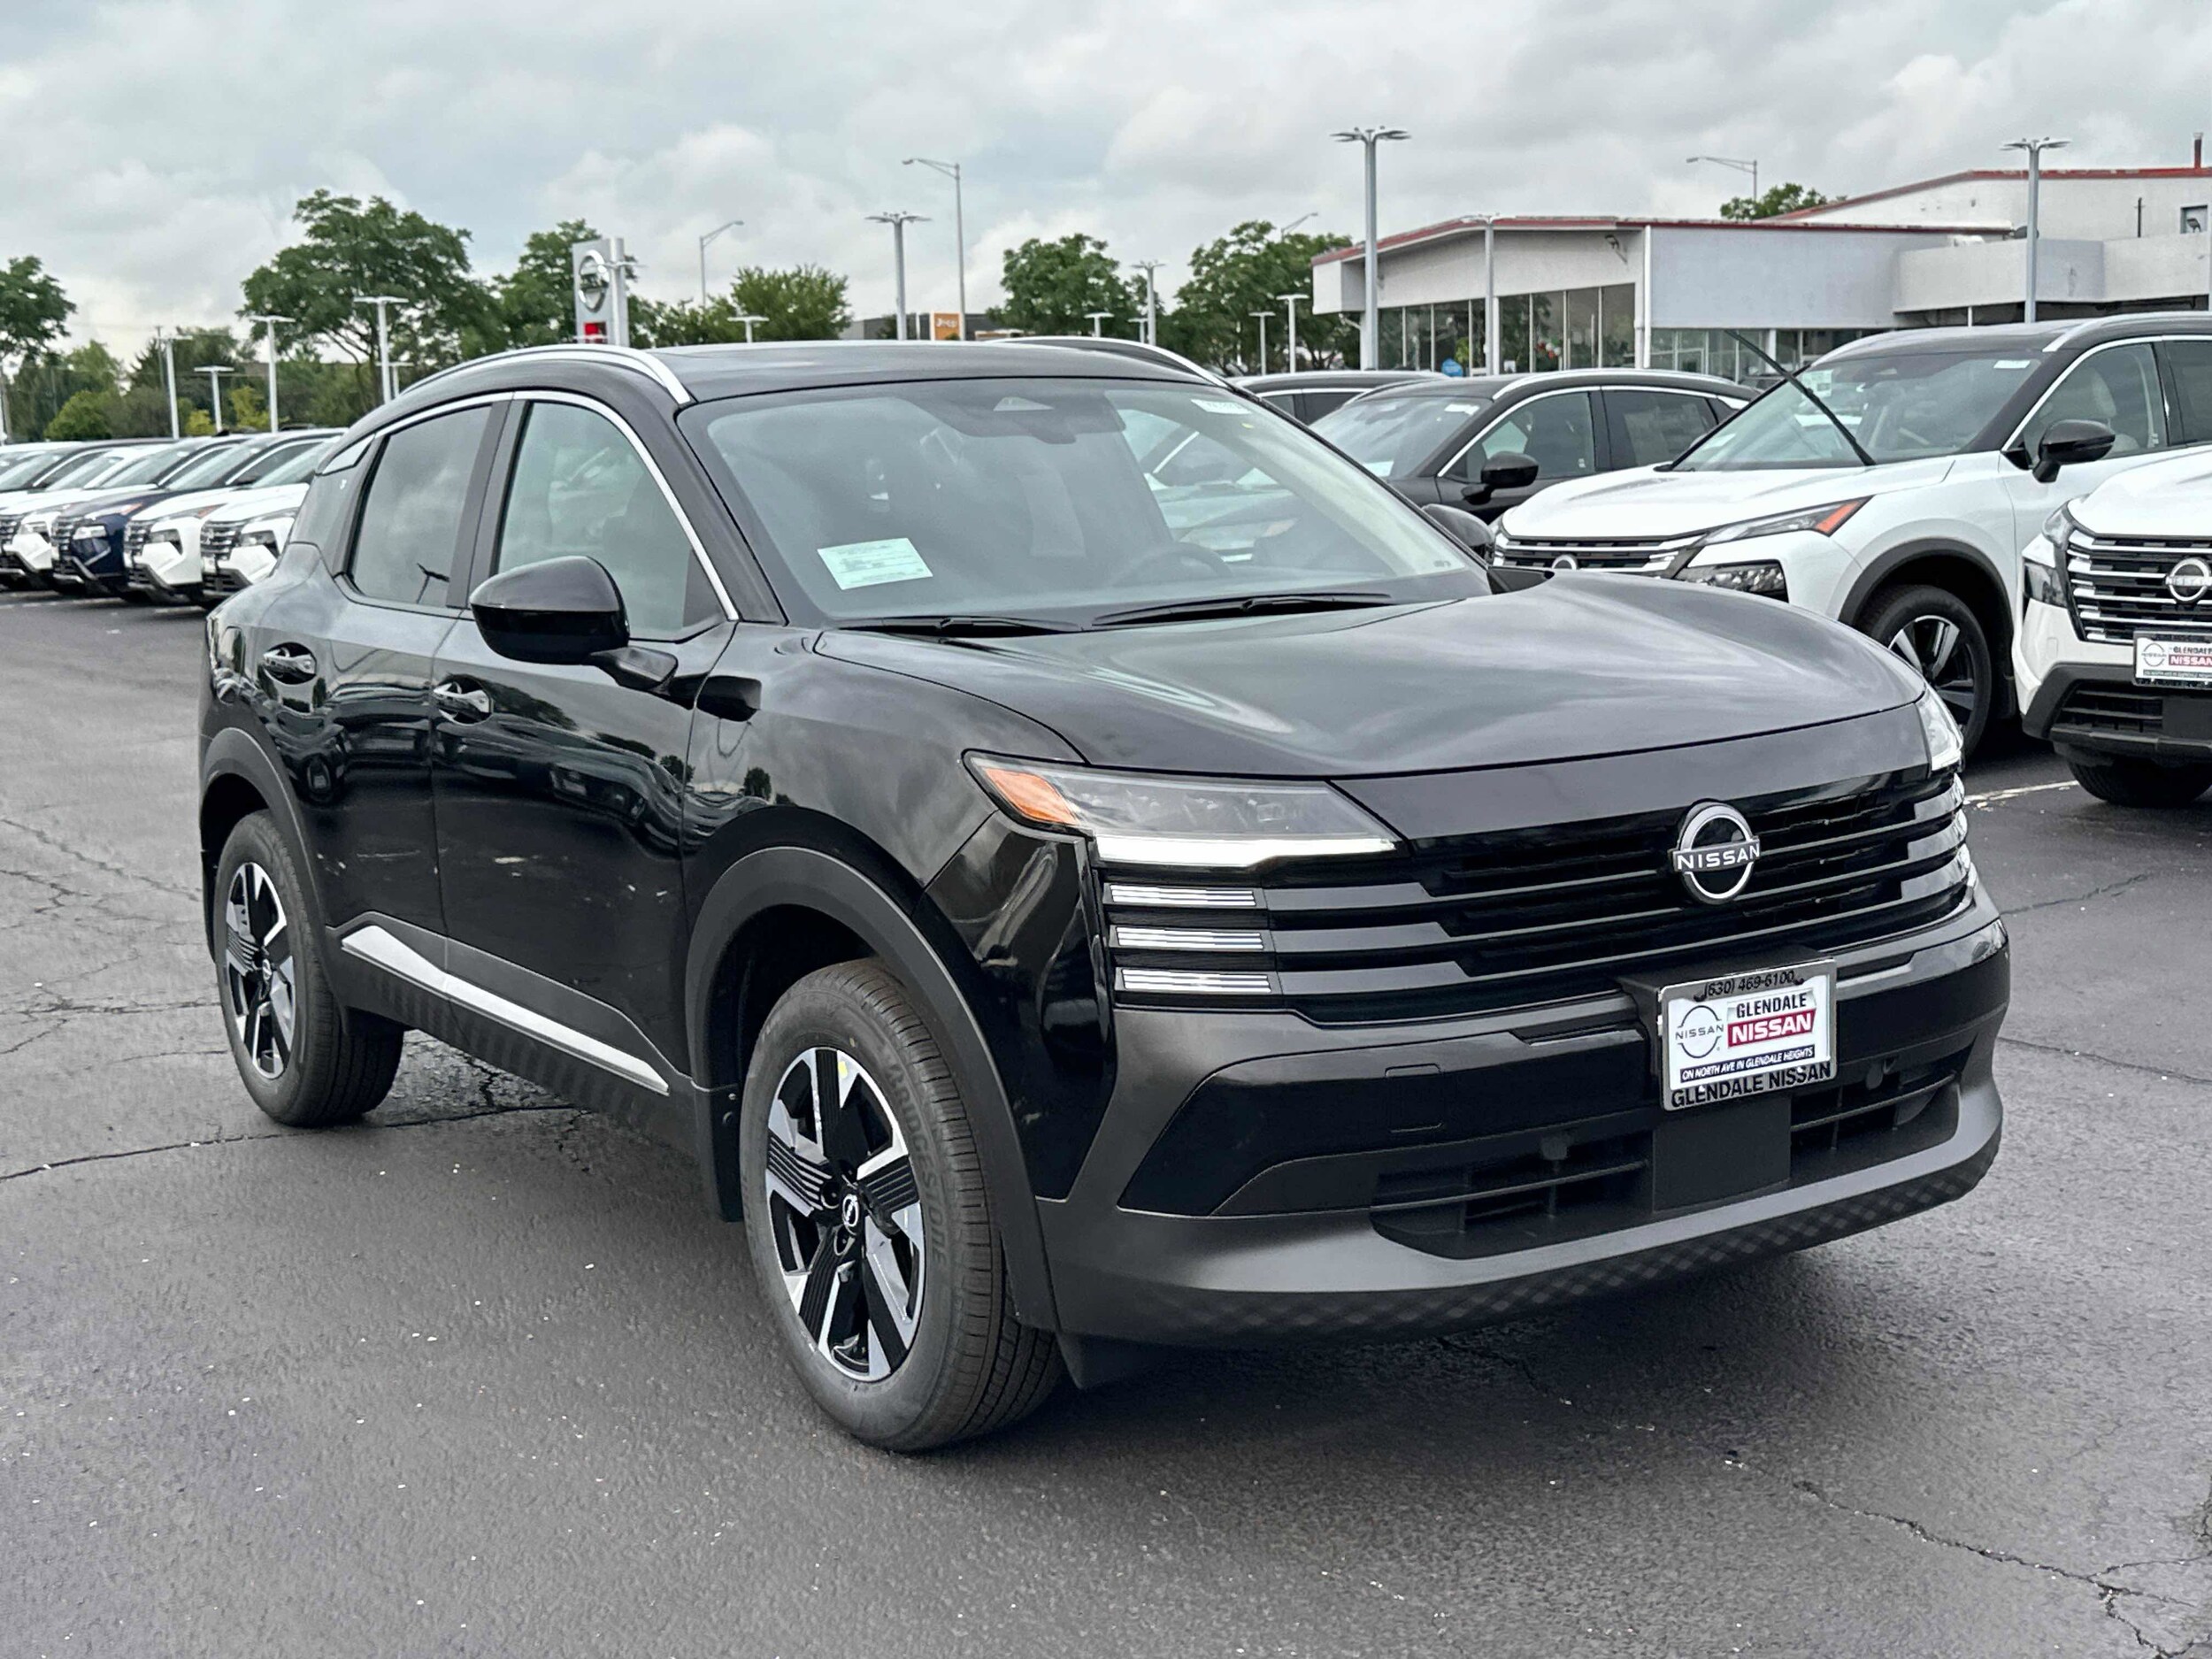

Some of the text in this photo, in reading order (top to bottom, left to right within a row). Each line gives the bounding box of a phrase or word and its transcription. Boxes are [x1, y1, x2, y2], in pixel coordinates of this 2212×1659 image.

[2170, 656, 2212, 665] NISSAN
[1677, 843, 1760, 870] NISSAN
[1704, 970, 1795, 997] (630) 469-6100
[1736, 992, 1807, 1018] GLENDALE
[1675, 1024, 1724, 1041] NISSAN
[1732, 1012, 1814, 1044] NISSAN
[1682, 1047, 1814, 1080] ON NORTH AVE IN GLENDALE HEIGHTS
[1671, 1061, 1832, 1108] GLENDALE NISSAN
